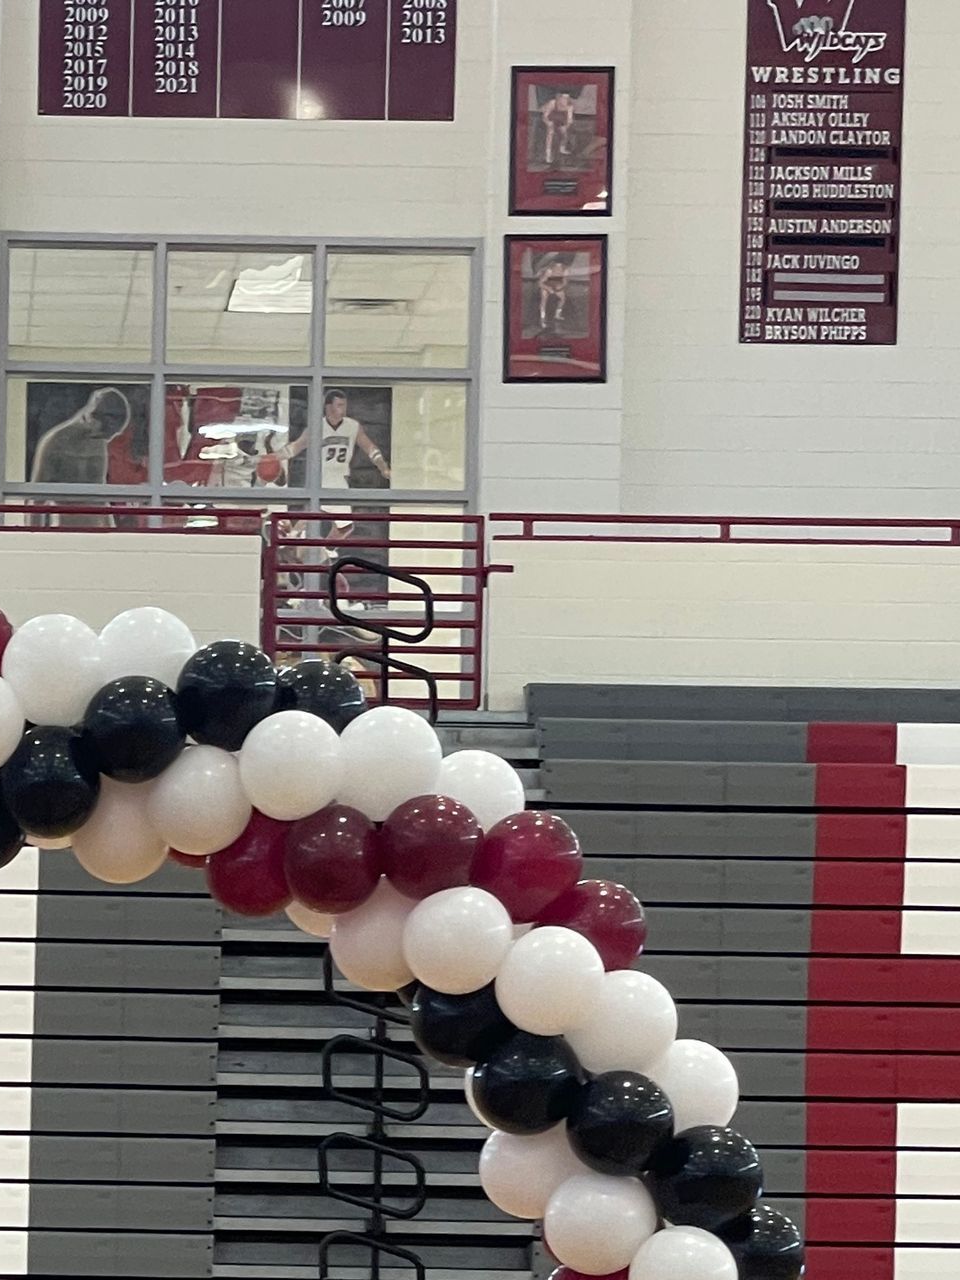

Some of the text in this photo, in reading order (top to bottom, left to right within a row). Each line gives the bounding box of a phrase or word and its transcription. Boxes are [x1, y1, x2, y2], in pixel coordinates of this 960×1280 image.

[64, 7, 109, 23] 2009
[154, 8, 197, 24] 2011
[321, 10, 366, 26] 2009
[401, 11, 446, 26] 2012
[63, 24, 108, 40] 2012
[154, 25, 199, 41] 2013
[401, 28, 446, 44] 2013
[63, 41, 104, 57] 2015
[155, 43, 195, 59] 2014
[63, 58, 108, 74] 2017
[154, 60, 199, 76] 2018
[63, 75, 108, 91] 2019
[751, 66, 901, 84] WRESTLING
[155, 77, 198, 93] 2021
[62, 92, 107, 108] 2020
[772, 94, 804, 109] JOSH
[807, 94, 848, 109] SMITH
[771, 112, 827, 127] AKSHAY
[828, 113, 869, 128] OLLEY
[770, 130, 826, 145] LANDON
[829, 130, 891, 145] CLAYTOR
[769, 166, 829, 181] JACKSON
[832, 166, 873, 181] MILLS
[769, 183, 809, 198] JACOB
[812, 183, 894, 199] HUDDLESTON
[768, 219, 817, 234] AUSTIN
[819, 219, 892, 234] ANDERSON
[766, 254, 800, 269] JACK
[803, 254, 860, 270] JUVINGO
[807, 308, 866, 323] WILCHER
[764, 325, 817, 340] BRYSON
[820, 325, 868, 341] PHIPPS
